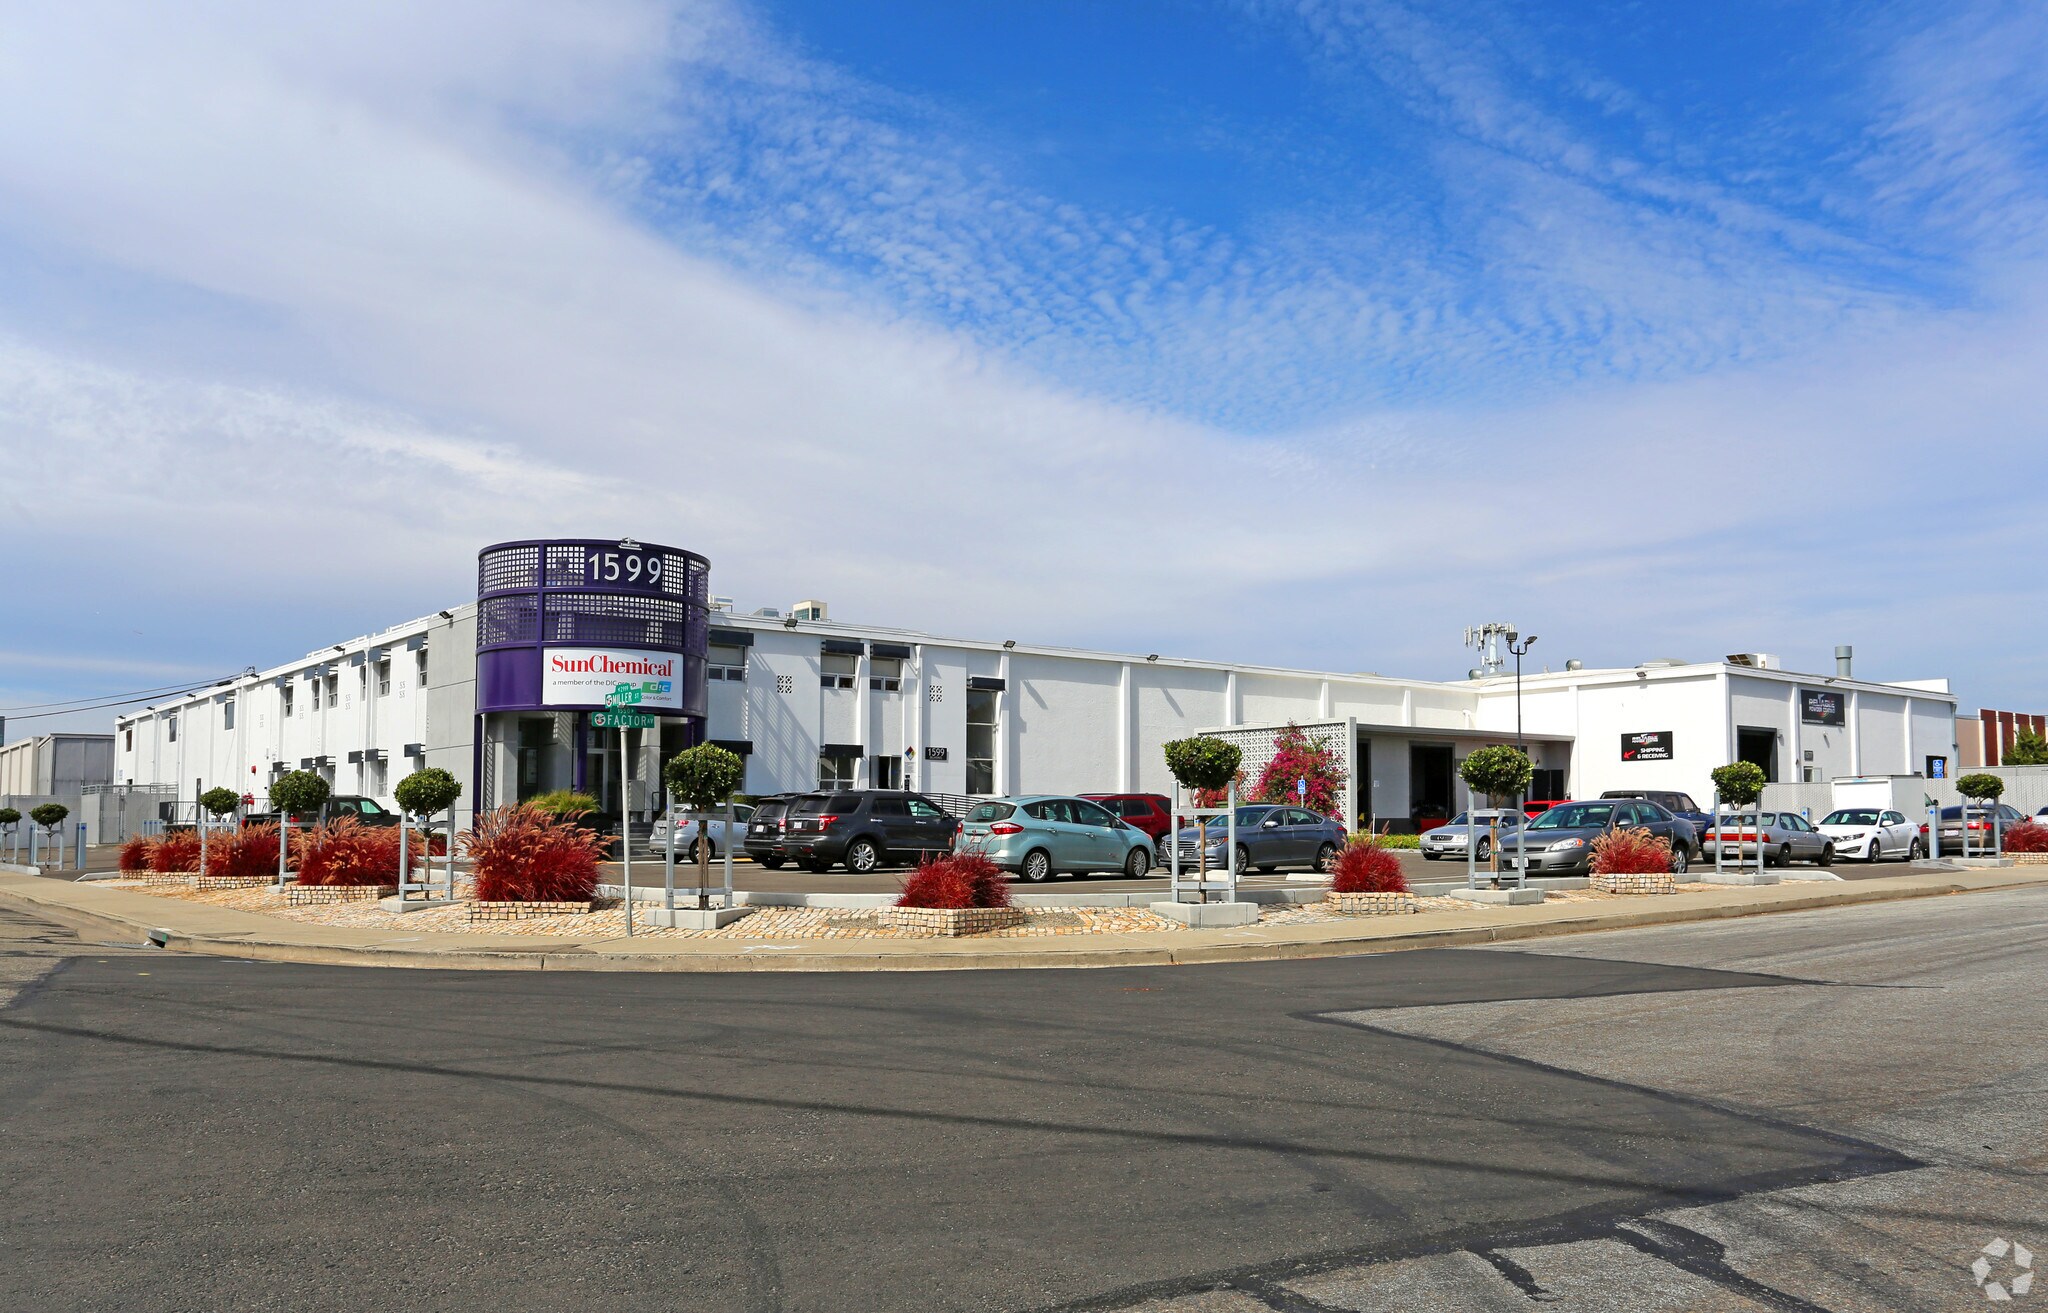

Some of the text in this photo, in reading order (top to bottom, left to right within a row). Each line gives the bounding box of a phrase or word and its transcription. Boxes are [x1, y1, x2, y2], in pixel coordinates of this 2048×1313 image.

[588, 553, 661, 584] 1599
[552, 655, 673, 677] SunChemical
[612, 692, 633, 706] MILLER
[608, 714, 647, 726] FACTOR
[928, 748, 945, 757] 1599
